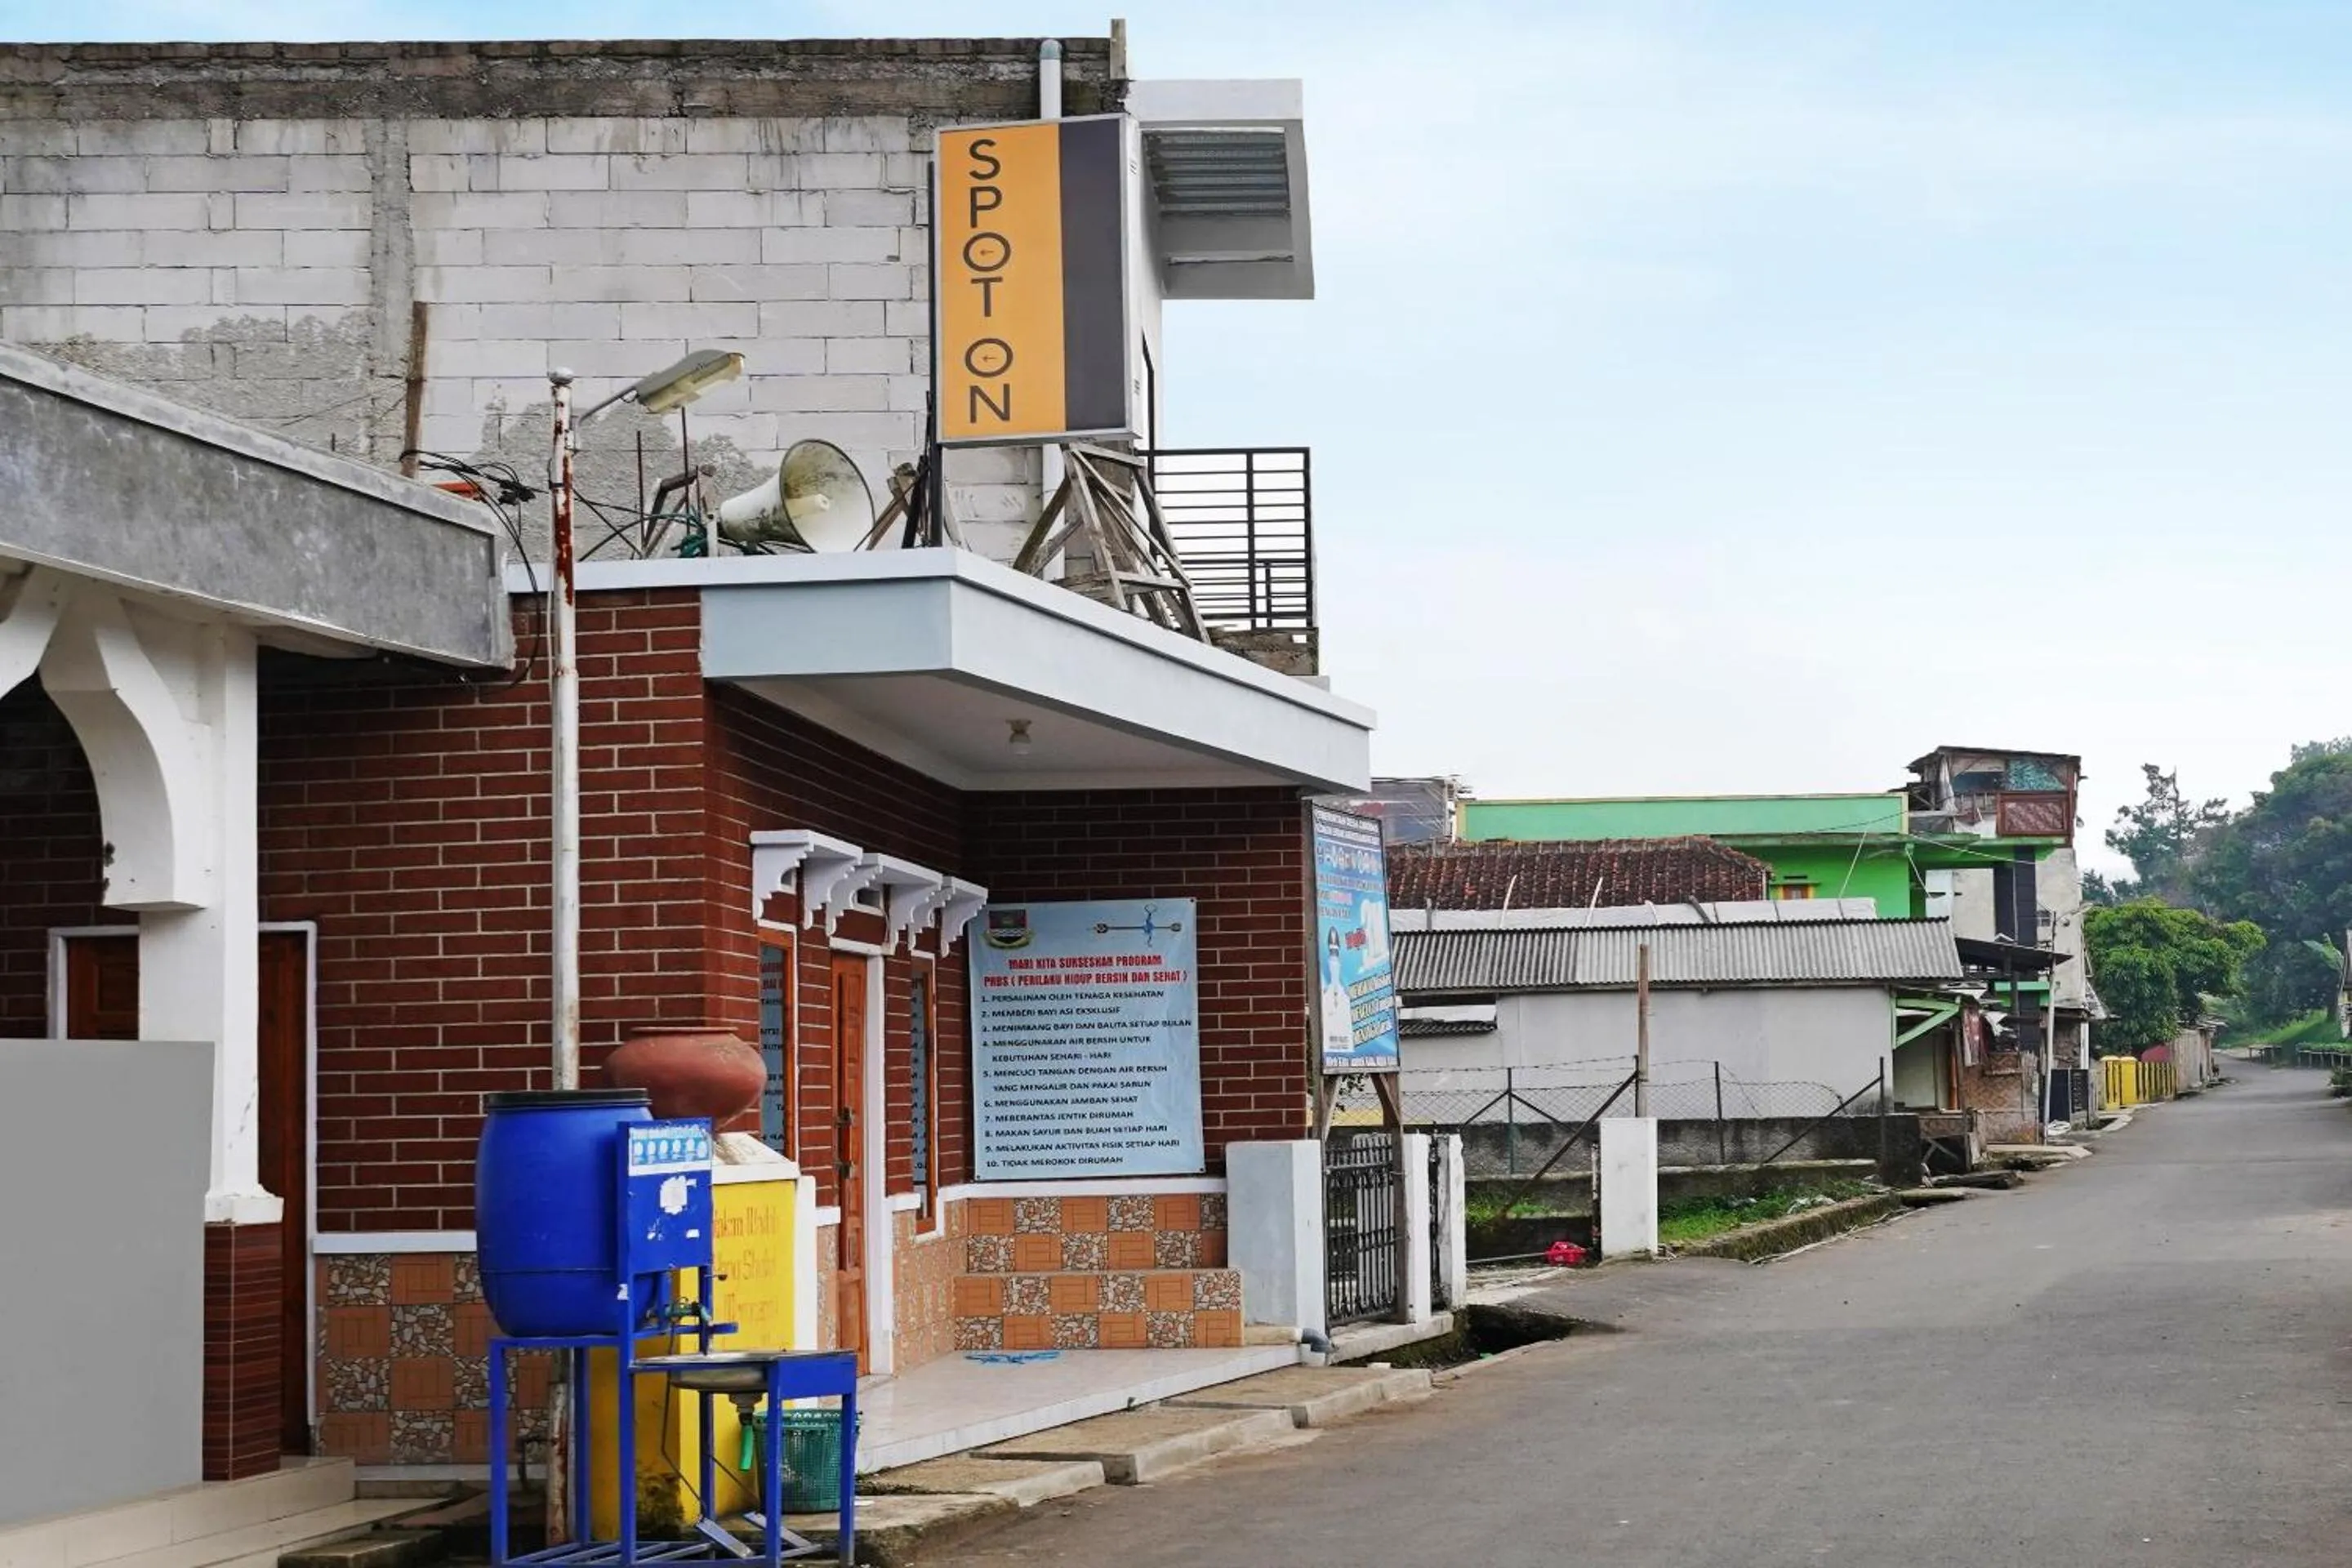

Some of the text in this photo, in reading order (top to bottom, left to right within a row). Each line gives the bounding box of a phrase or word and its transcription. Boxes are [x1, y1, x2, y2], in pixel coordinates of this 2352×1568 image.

[1008, 955, 1162, 969] MARI KITA SUKSESKAN PROGRAM
[1018, 973, 1062, 986] PERILAKU
[1064, 973, 1092, 985] HIDUP
[1095, 972, 1128, 984] BERSIH
[1131, 971, 1150, 982] DAN
[1152, 970, 1181, 982] SEHAT
[991, 994, 1046, 1002] PERSALINAN
[1076, 1006, 1120, 1014] EKSKLUSIF
[1097, 1021, 1128, 1029] BALITA
[1129, 1020, 1160, 1028] SETIAP
[1161, 1019, 1192, 1027] BULAN
[992, 1038, 1067, 1046] MENGGUNAKAN
[1086, 1036, 1117, 1045] BERSIH
[1119, 1036, 1151, 1044] UNTUK
[1078, 1067, 1116, 1075] DENGAN
[1020, 1083, 1067, 1091] MENGALIR
[1070, 1082, 1089, 1090] DAN
[1120, 1080, 1152, 1089] SABUN
[995, 1098, 1068, 1107] MENGGUNAKAN
[1071, 1097, 1108, 1105] JAMBAN
[1058, 1112, 1087, 1120] JENTIK
[1089, 1111, 1134, 1119] DIRUMAH
[1112, 1125, 1143, 1134] SETIAP
[1146, 1125, 1168, 1133] HARI
[995, 1144, 1053, 1152] MELAKUKAN
[1054, 1142, 1100, 1150] AKTIVITAS
[1125, 1140, 1156, 1148] SETIAP
[1078, 1156, 1124, 1165] DIRUMAH
